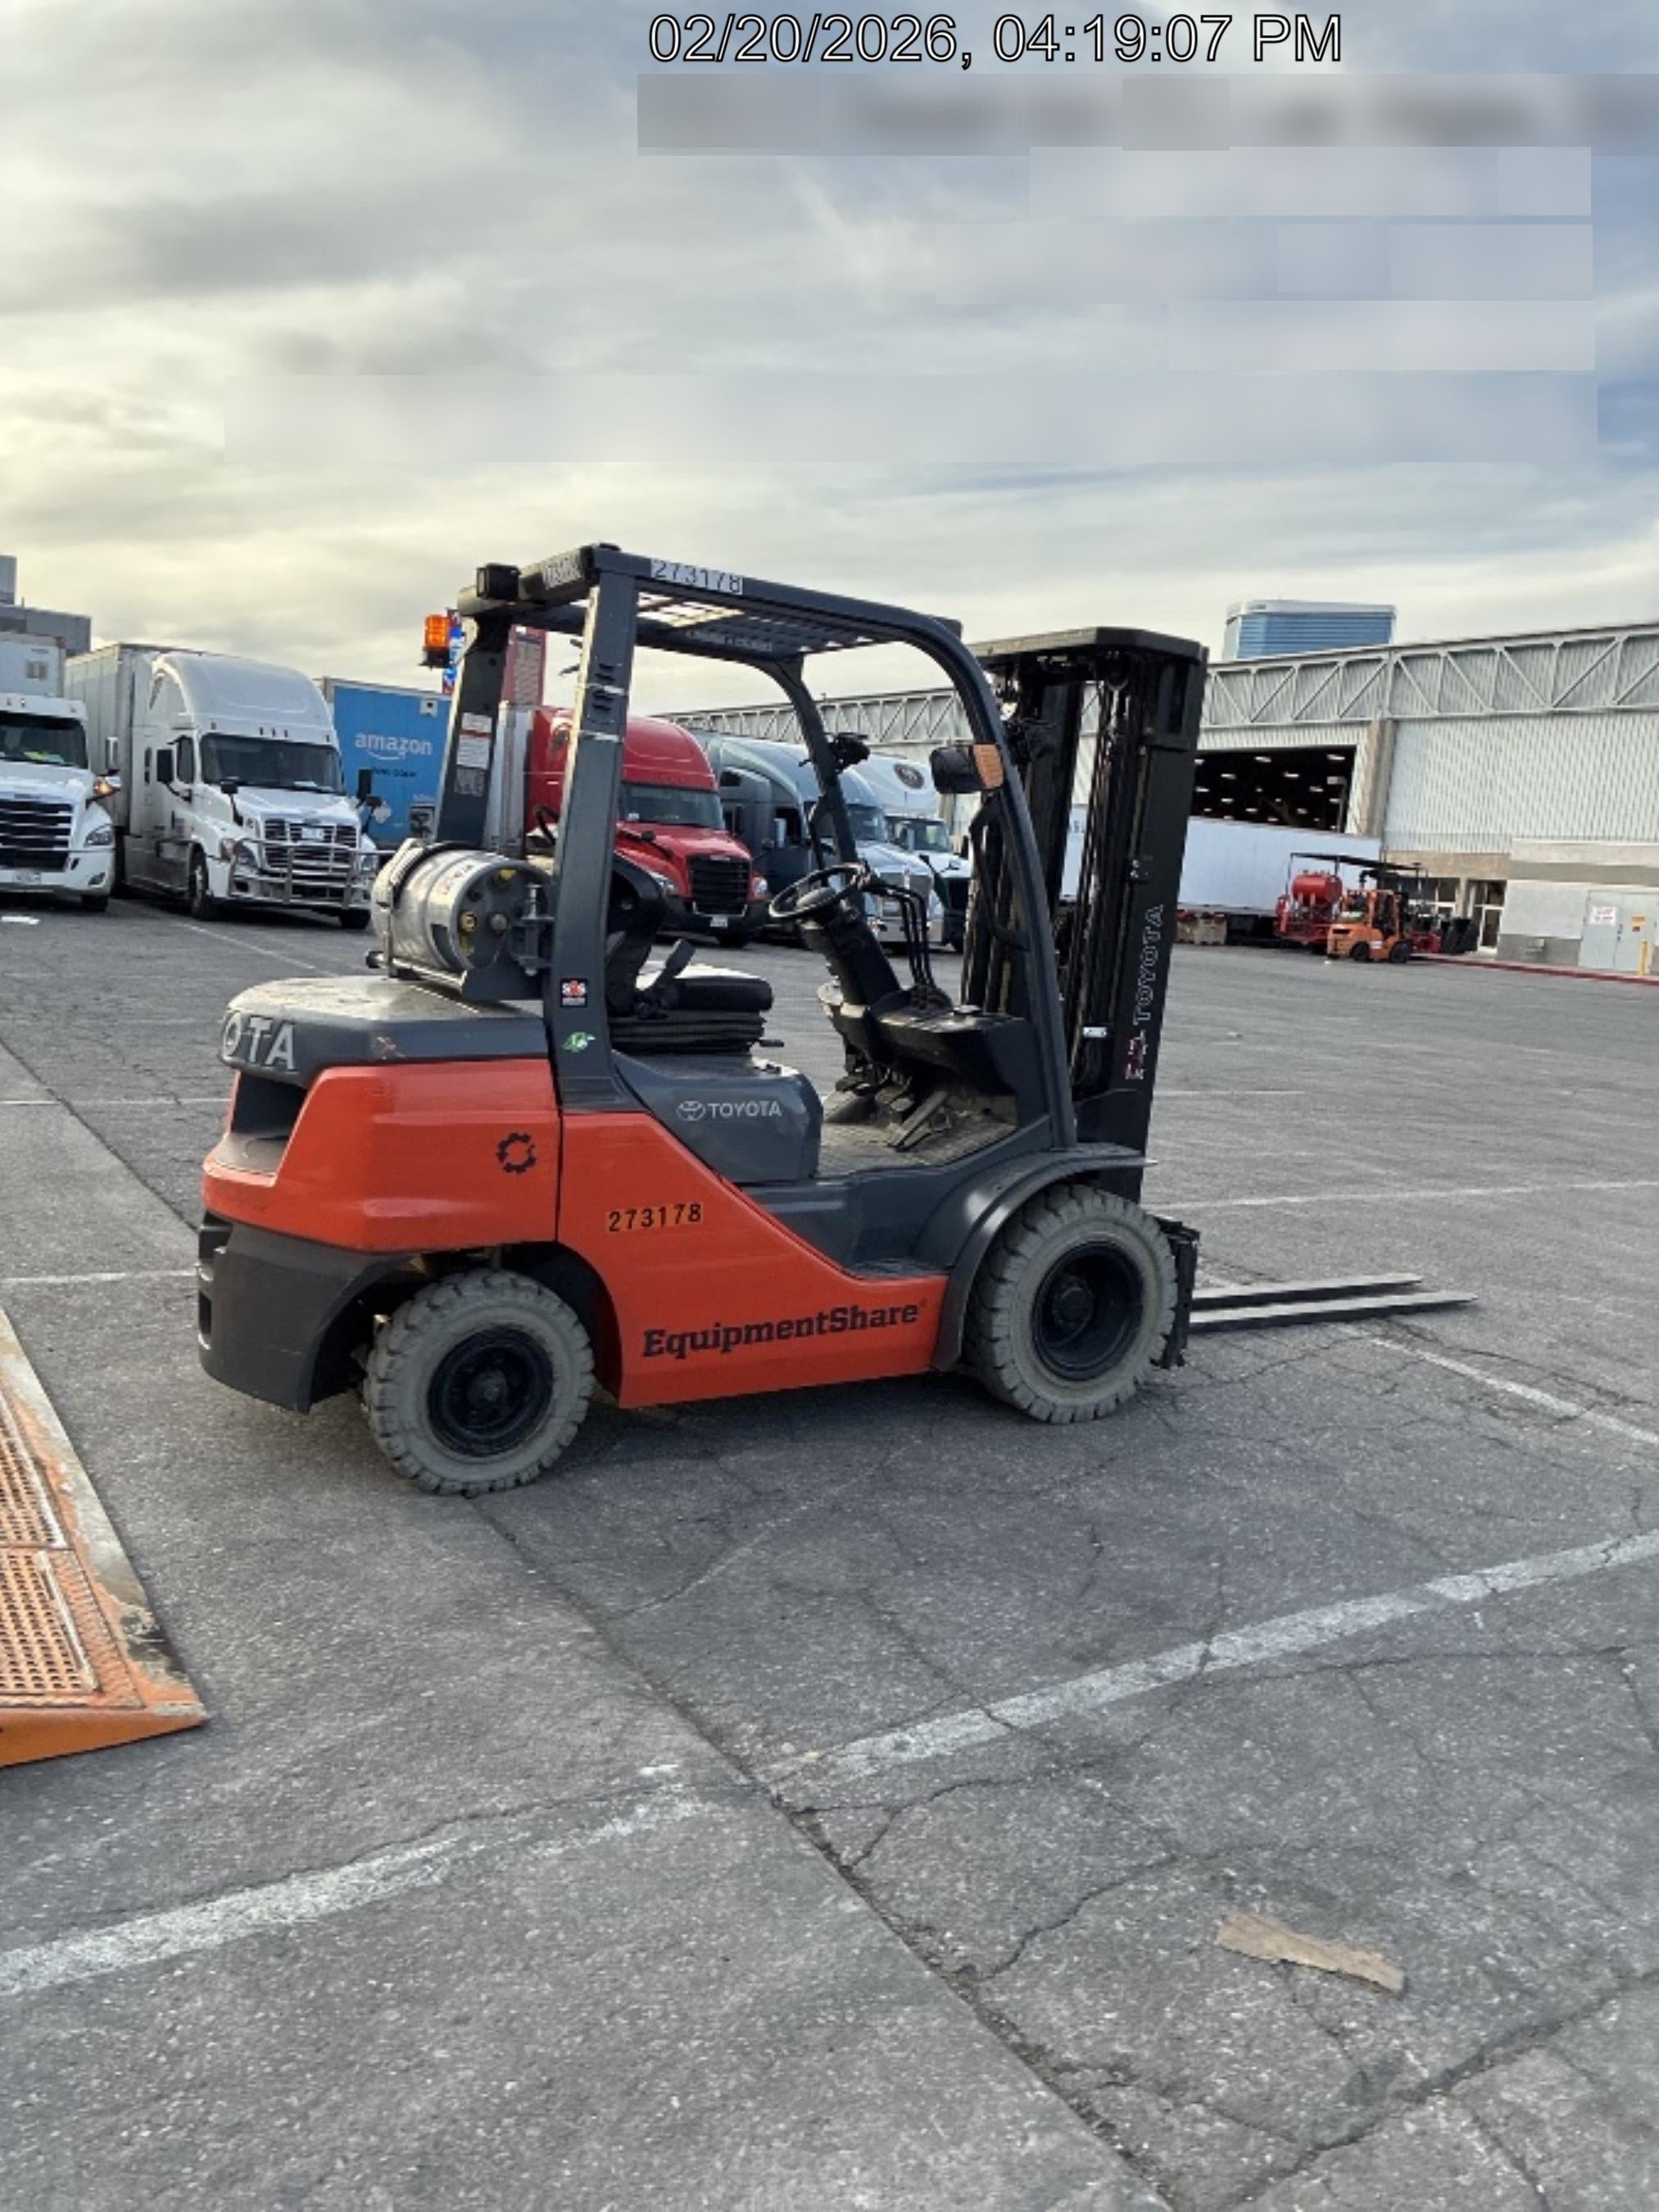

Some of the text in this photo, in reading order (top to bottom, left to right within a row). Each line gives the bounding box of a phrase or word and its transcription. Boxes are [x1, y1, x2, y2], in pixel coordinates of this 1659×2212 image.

[655, 560, 742, 593] 273178
[355, 732, 433, 756] amazon
[1133, 904, 1163, 1026] TOYOTA
[707, 1100, 782, 1118] TOYOTA
[609, 1203, 703, 1232] 273178
[642, 1303, 919, 1360] EquipmentShare
